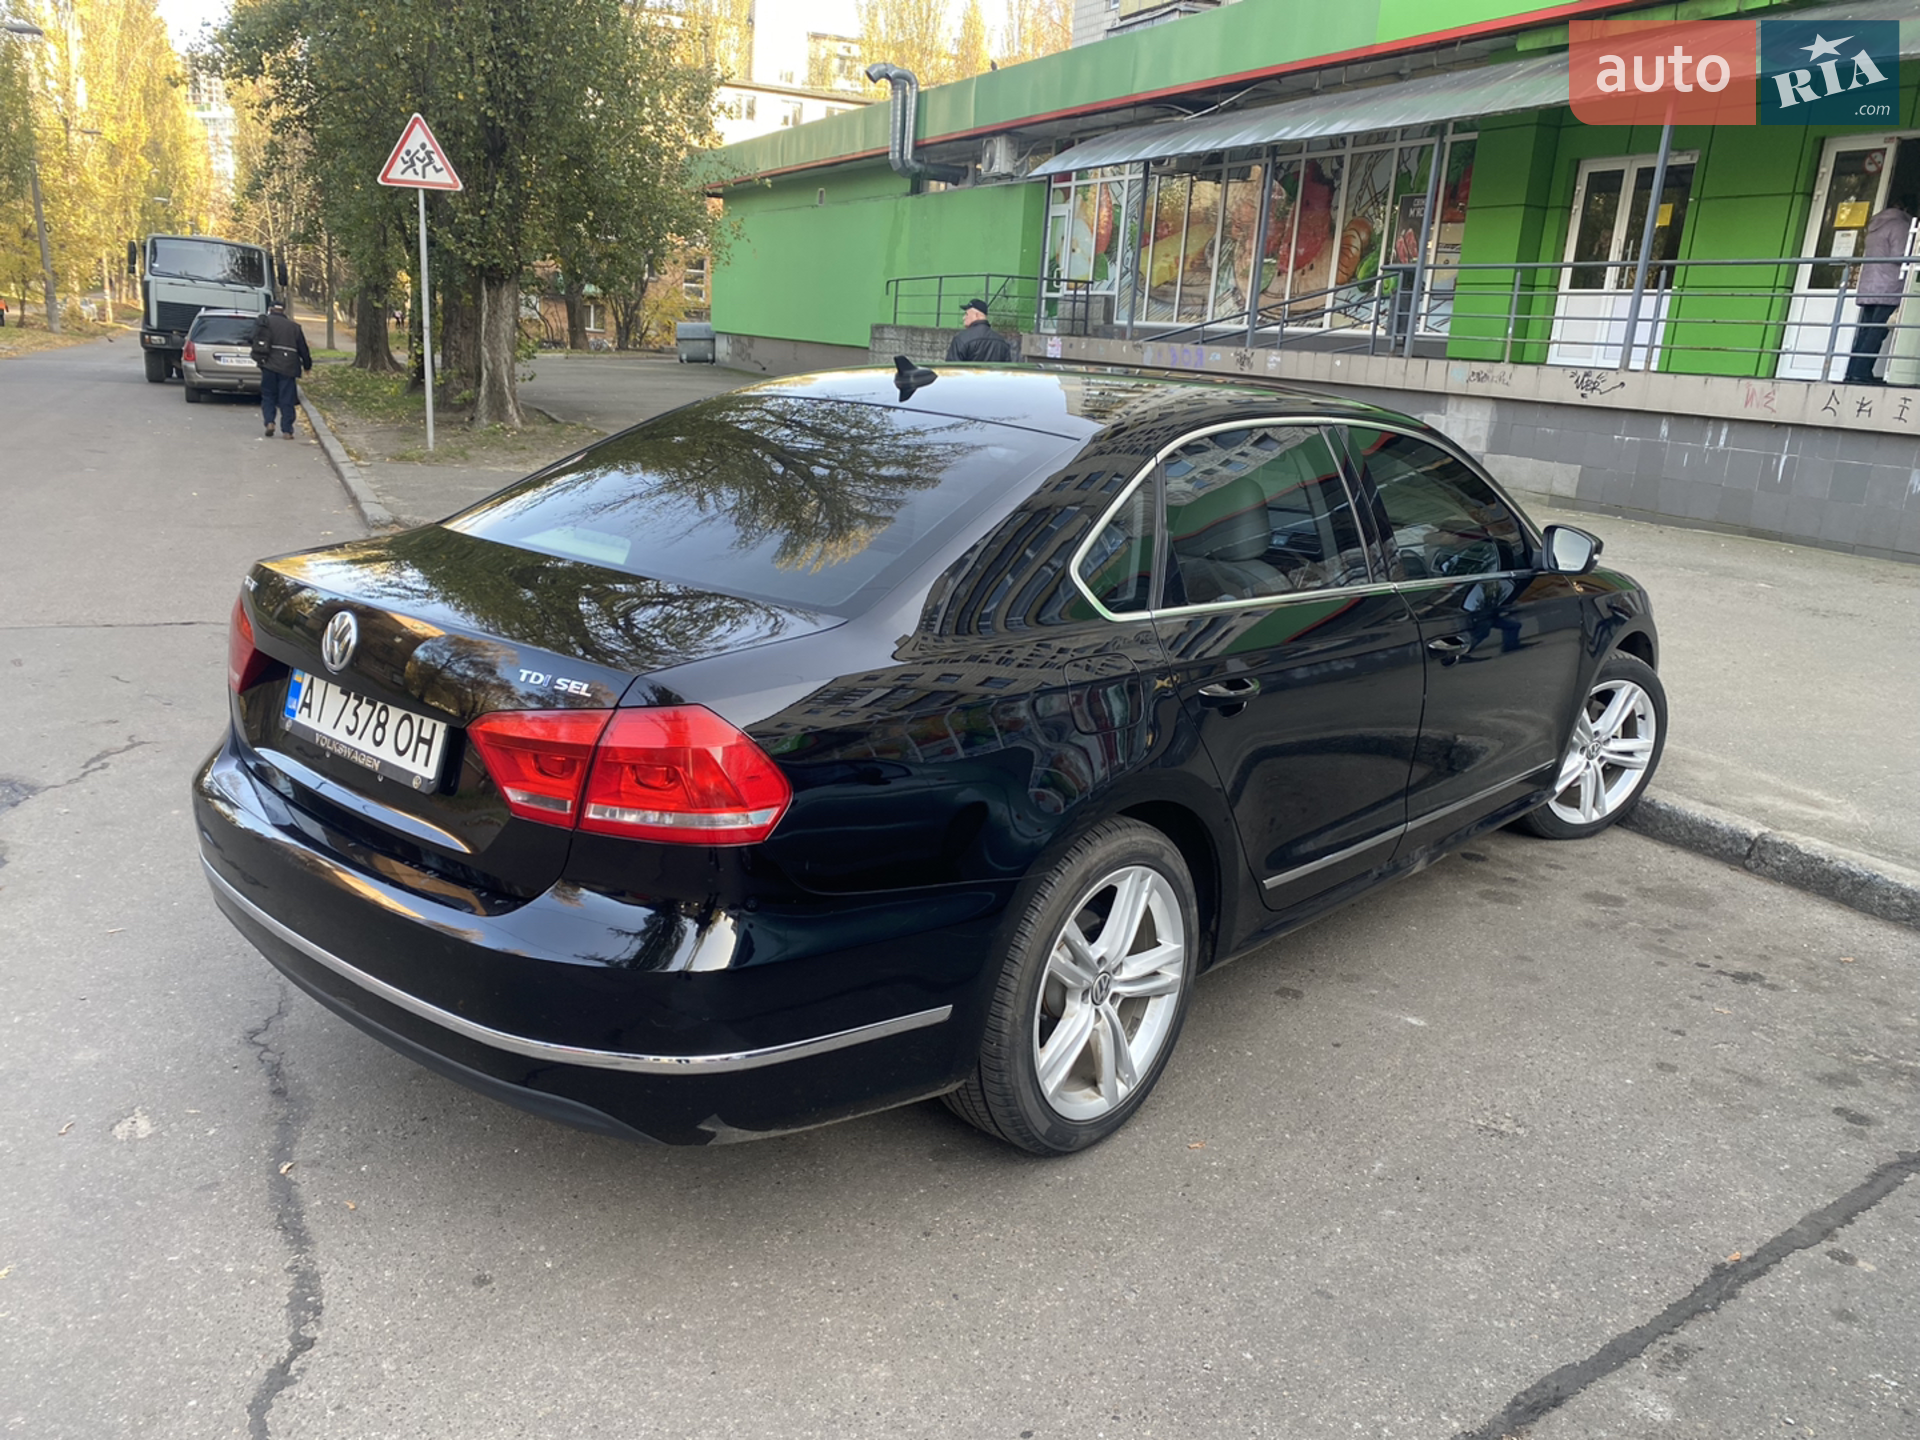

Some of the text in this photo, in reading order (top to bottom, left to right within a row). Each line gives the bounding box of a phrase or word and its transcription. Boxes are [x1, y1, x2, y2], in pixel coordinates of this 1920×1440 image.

[519, 668, 592, 697] TDI SEL
[333, 686, 390, 748] 7378
[394, 713, 437, 768] OH
[315, 732, 381, 772] VOLKSWAGEN
